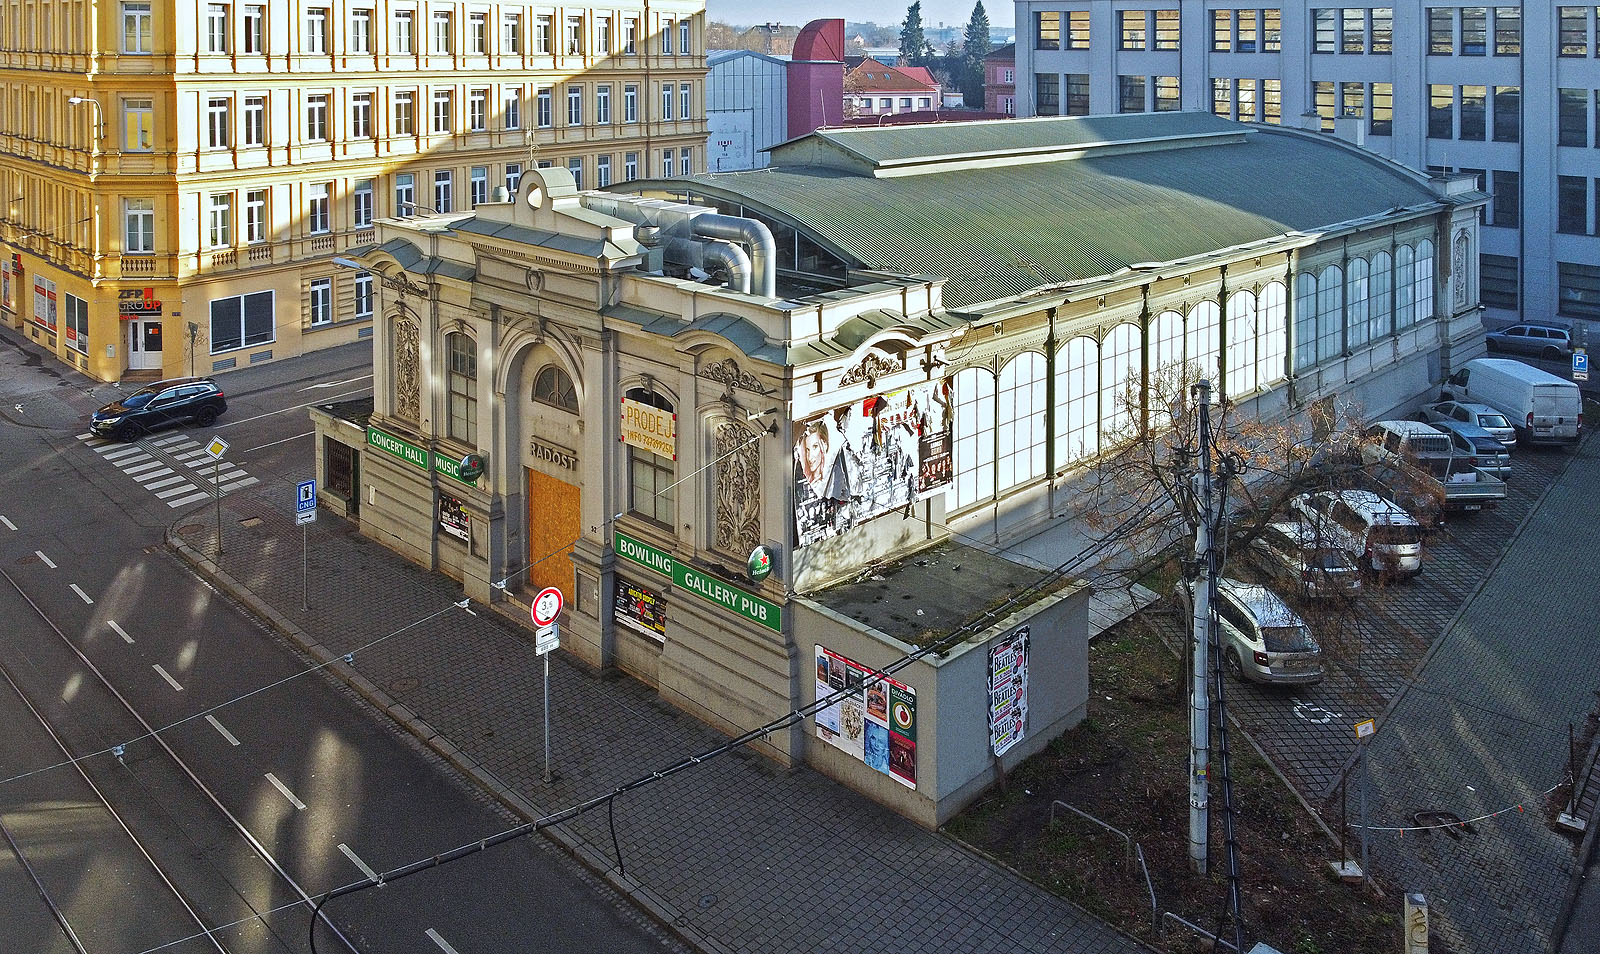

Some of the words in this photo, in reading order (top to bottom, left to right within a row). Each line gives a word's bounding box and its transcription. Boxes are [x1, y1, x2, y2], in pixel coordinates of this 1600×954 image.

[118, 289, 143, 299] ZFP
[118, 300, 161, 310] GROUP
[1576, 356, 1585, 366] P
[626, 405, 673, 439] PRODEJ
[371, 432, 404, 455] CONCERT
[405, 446, 424, 465] HALL
[530, 443, 577, 472] RADOST
[435, 457, 459, 477] MUSIC
[299, 500, 314, 510] CNG
[620, 539, 672, 573] BOWLING
[684, 572, 738, 607] GALLERY
[741, 597, 768, 621] PUB
[994, 652, 1017, 673] BEATLES
[994, 687, 1016, 707] BEATLES
[994, 719, 1016, 740] BEATLES
